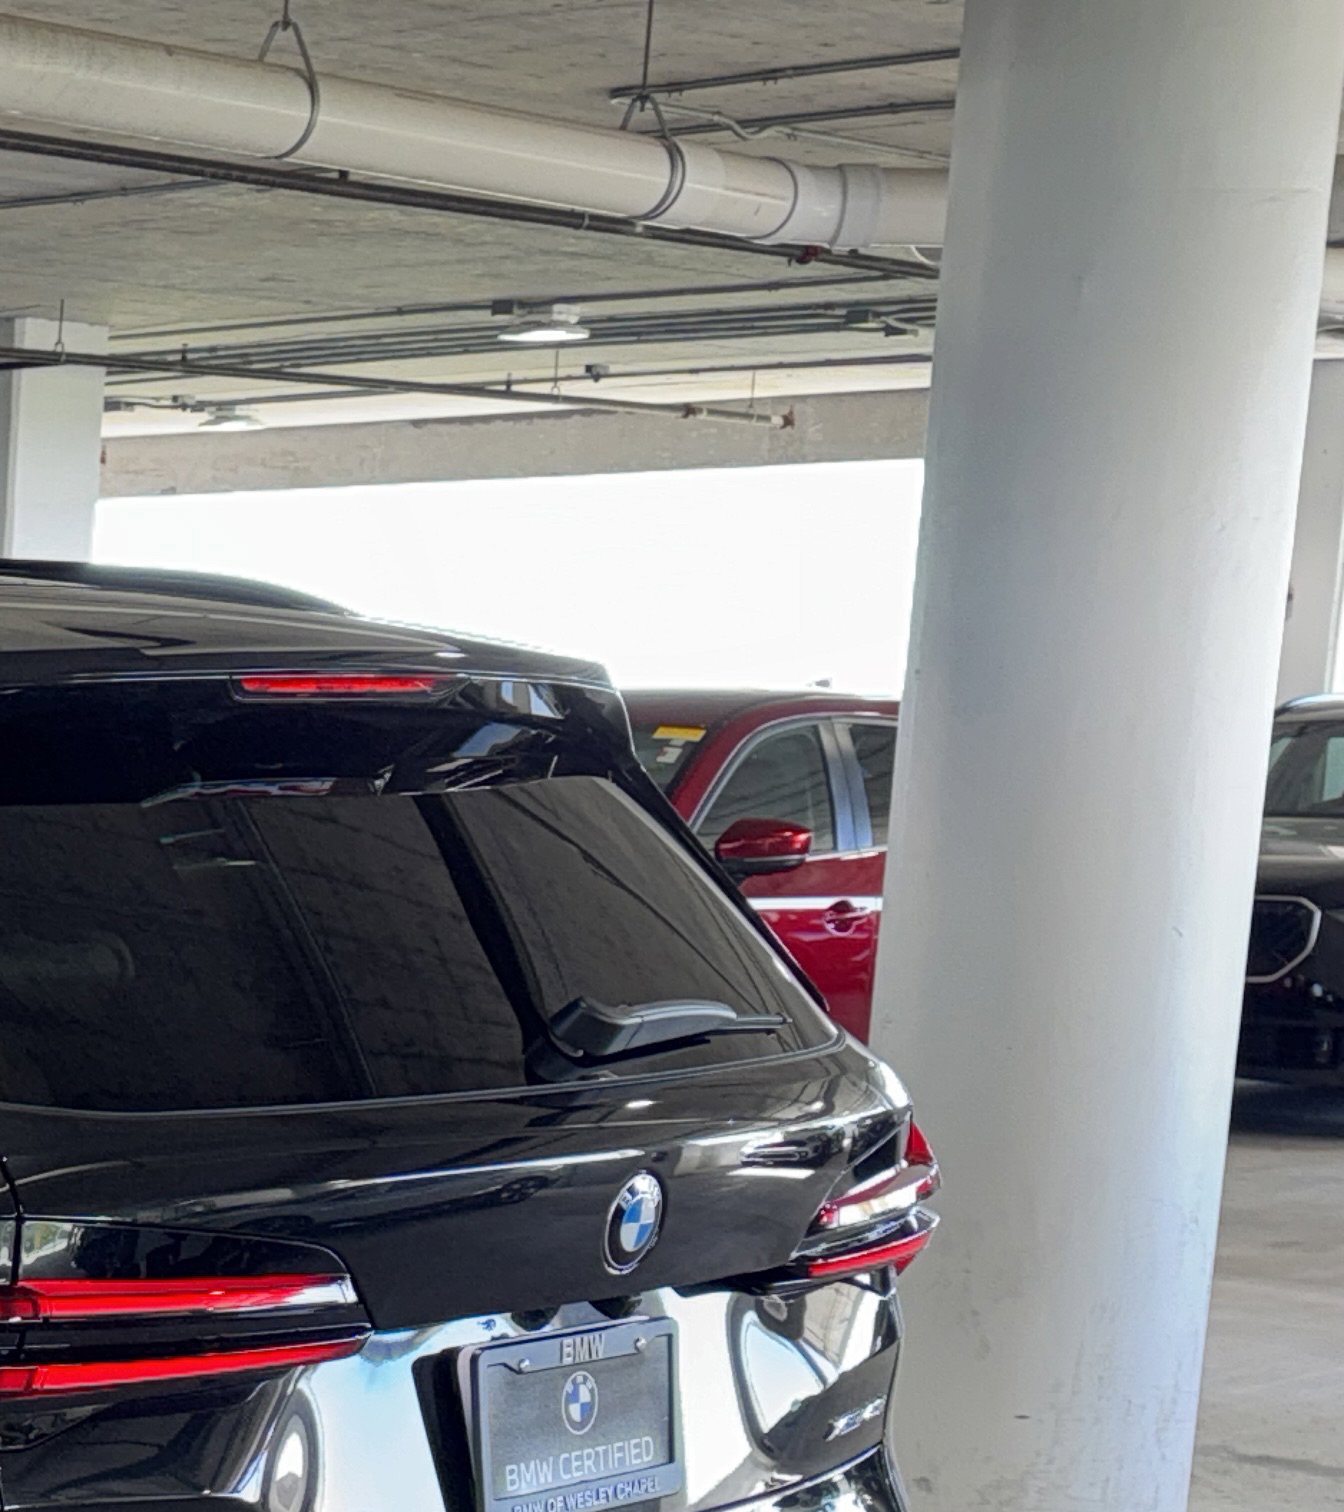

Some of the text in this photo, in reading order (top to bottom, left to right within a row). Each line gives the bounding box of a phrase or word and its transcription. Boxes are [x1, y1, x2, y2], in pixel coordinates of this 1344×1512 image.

[560, 1333, 605, 1364] BMW
[505, 1436, 654, 1491] BMW CERTIFIED
[566, 1487, 612, 1511] WESLEY
[615, 1475, 660, 1500] CHAPEL
